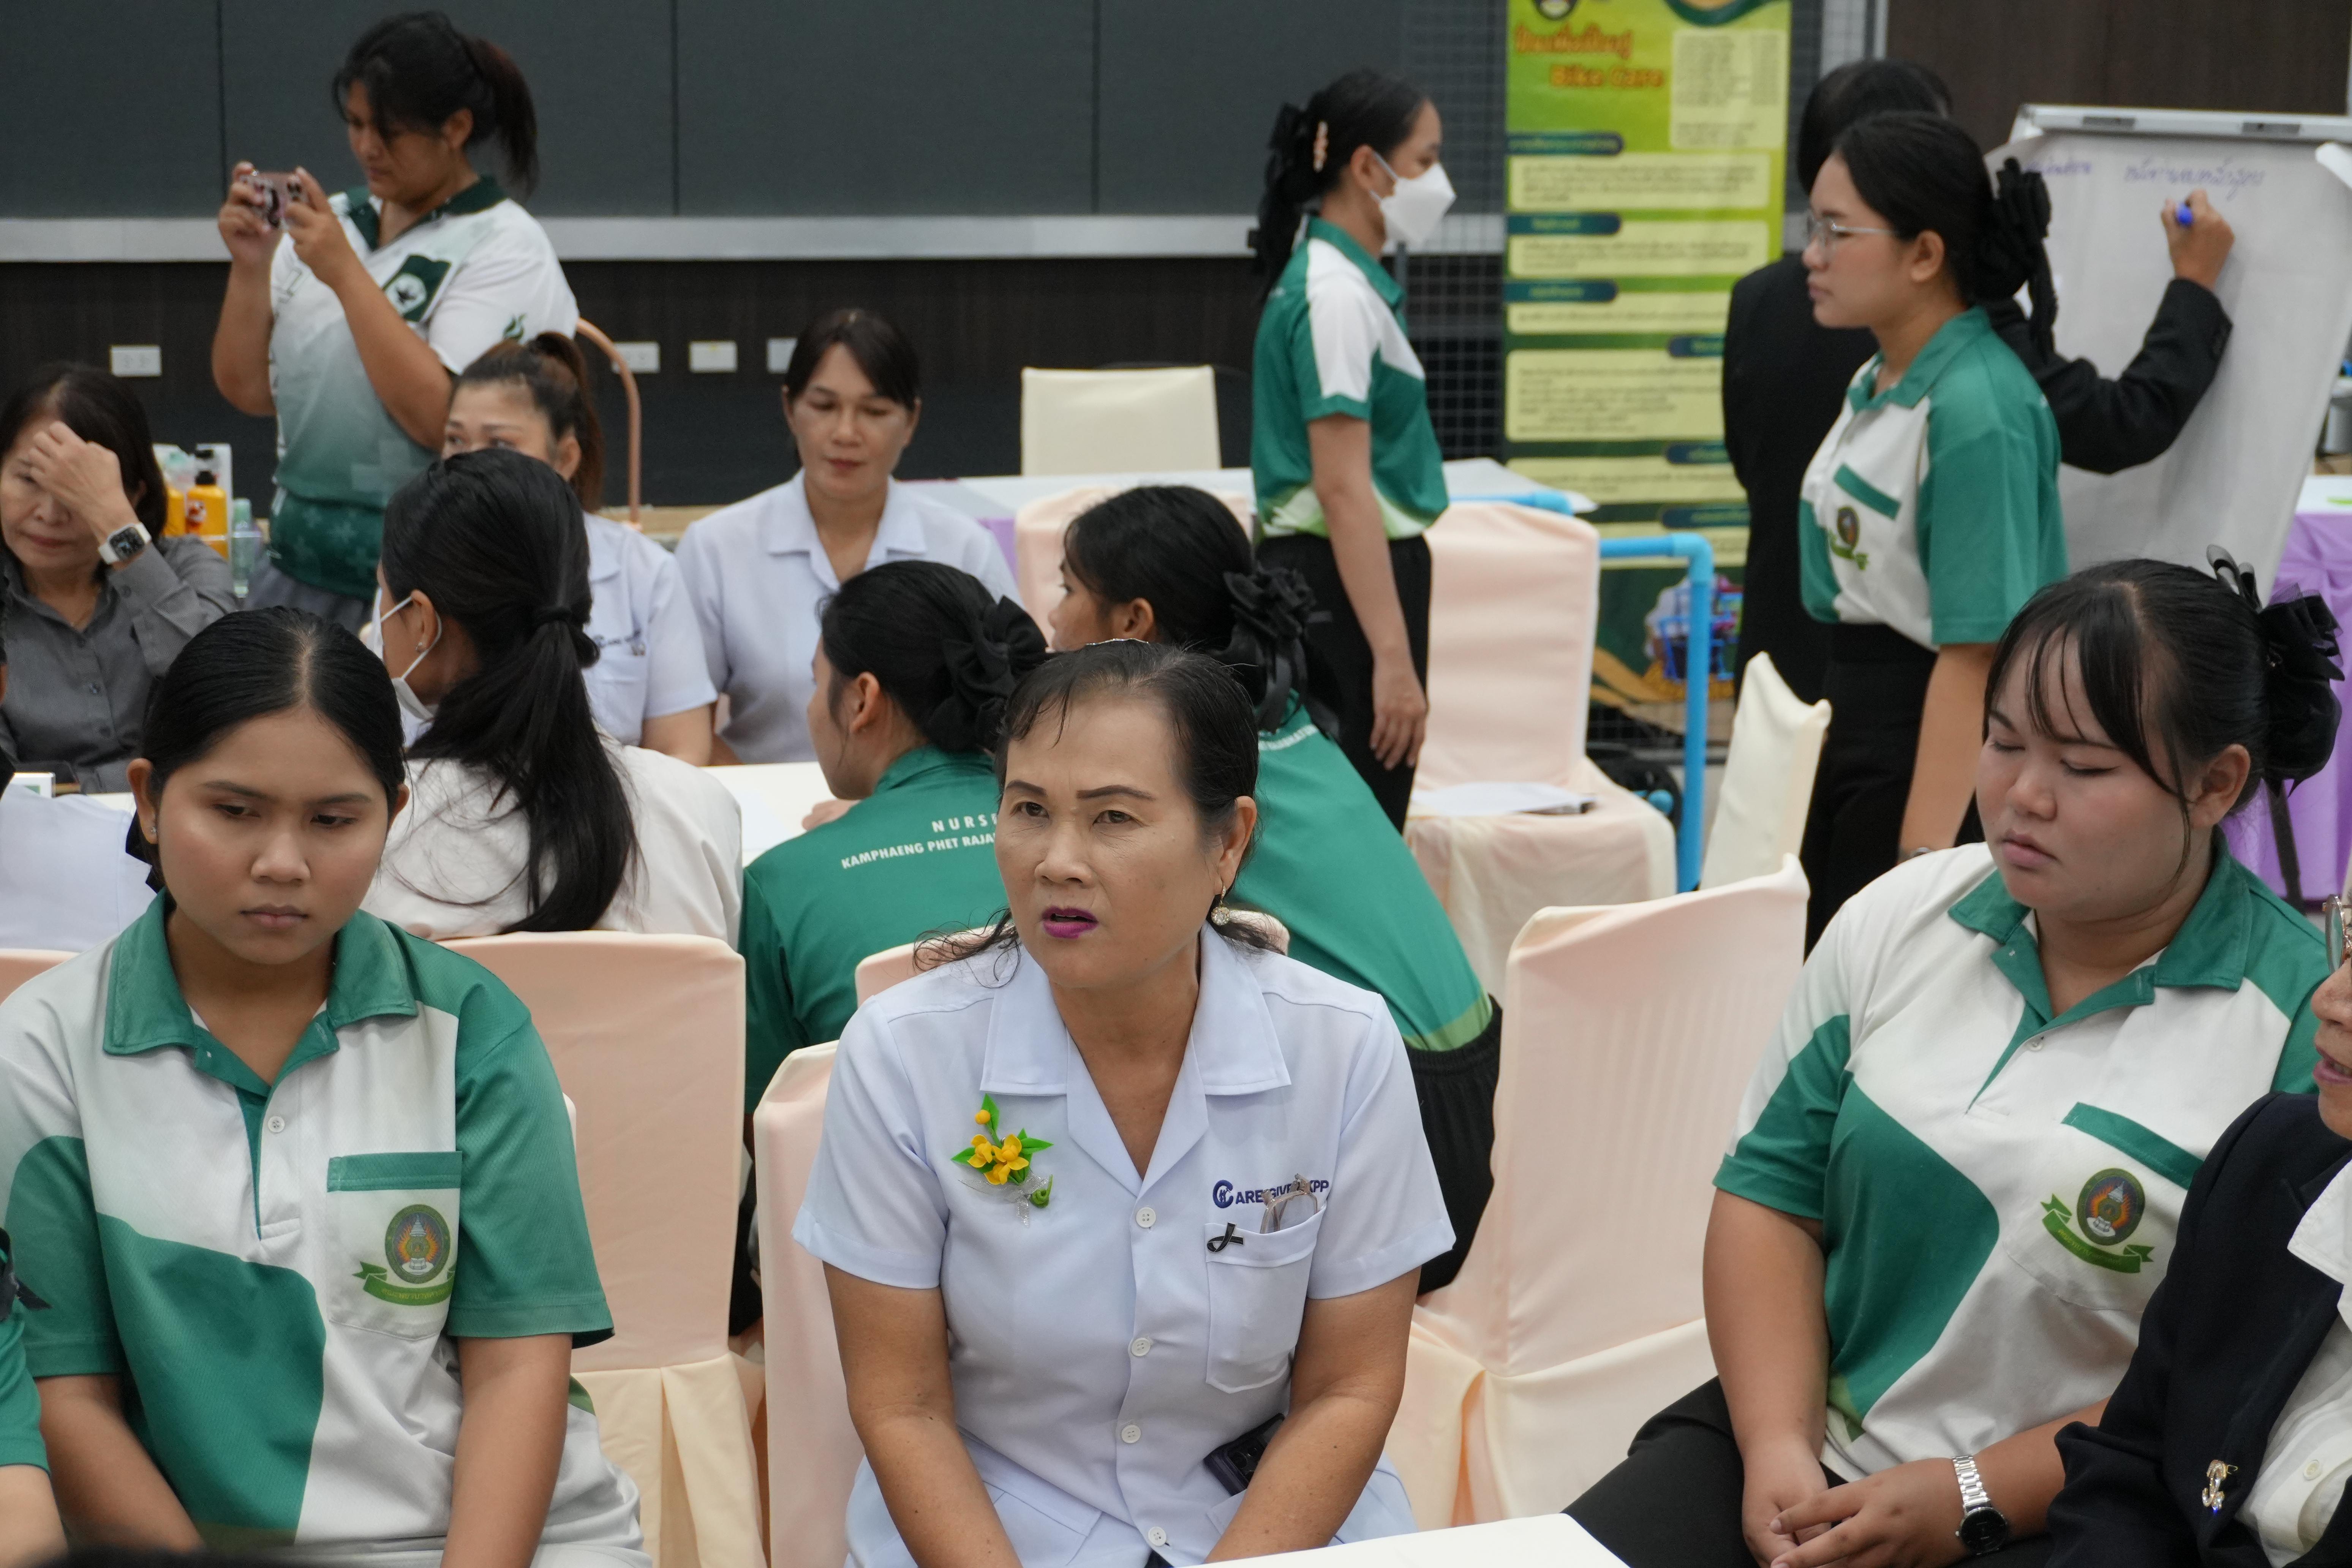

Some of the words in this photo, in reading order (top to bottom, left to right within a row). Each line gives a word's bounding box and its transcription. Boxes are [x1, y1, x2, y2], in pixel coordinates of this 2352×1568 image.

[1611, 64, 1664, 87] Care
[841, 842, 925, 869] KAMPHAENG
[927, 838, 958, 851] PHET
[962, 832, 995, 847] RAJA
[1270, 1182, 1300, 1198] GIVE
